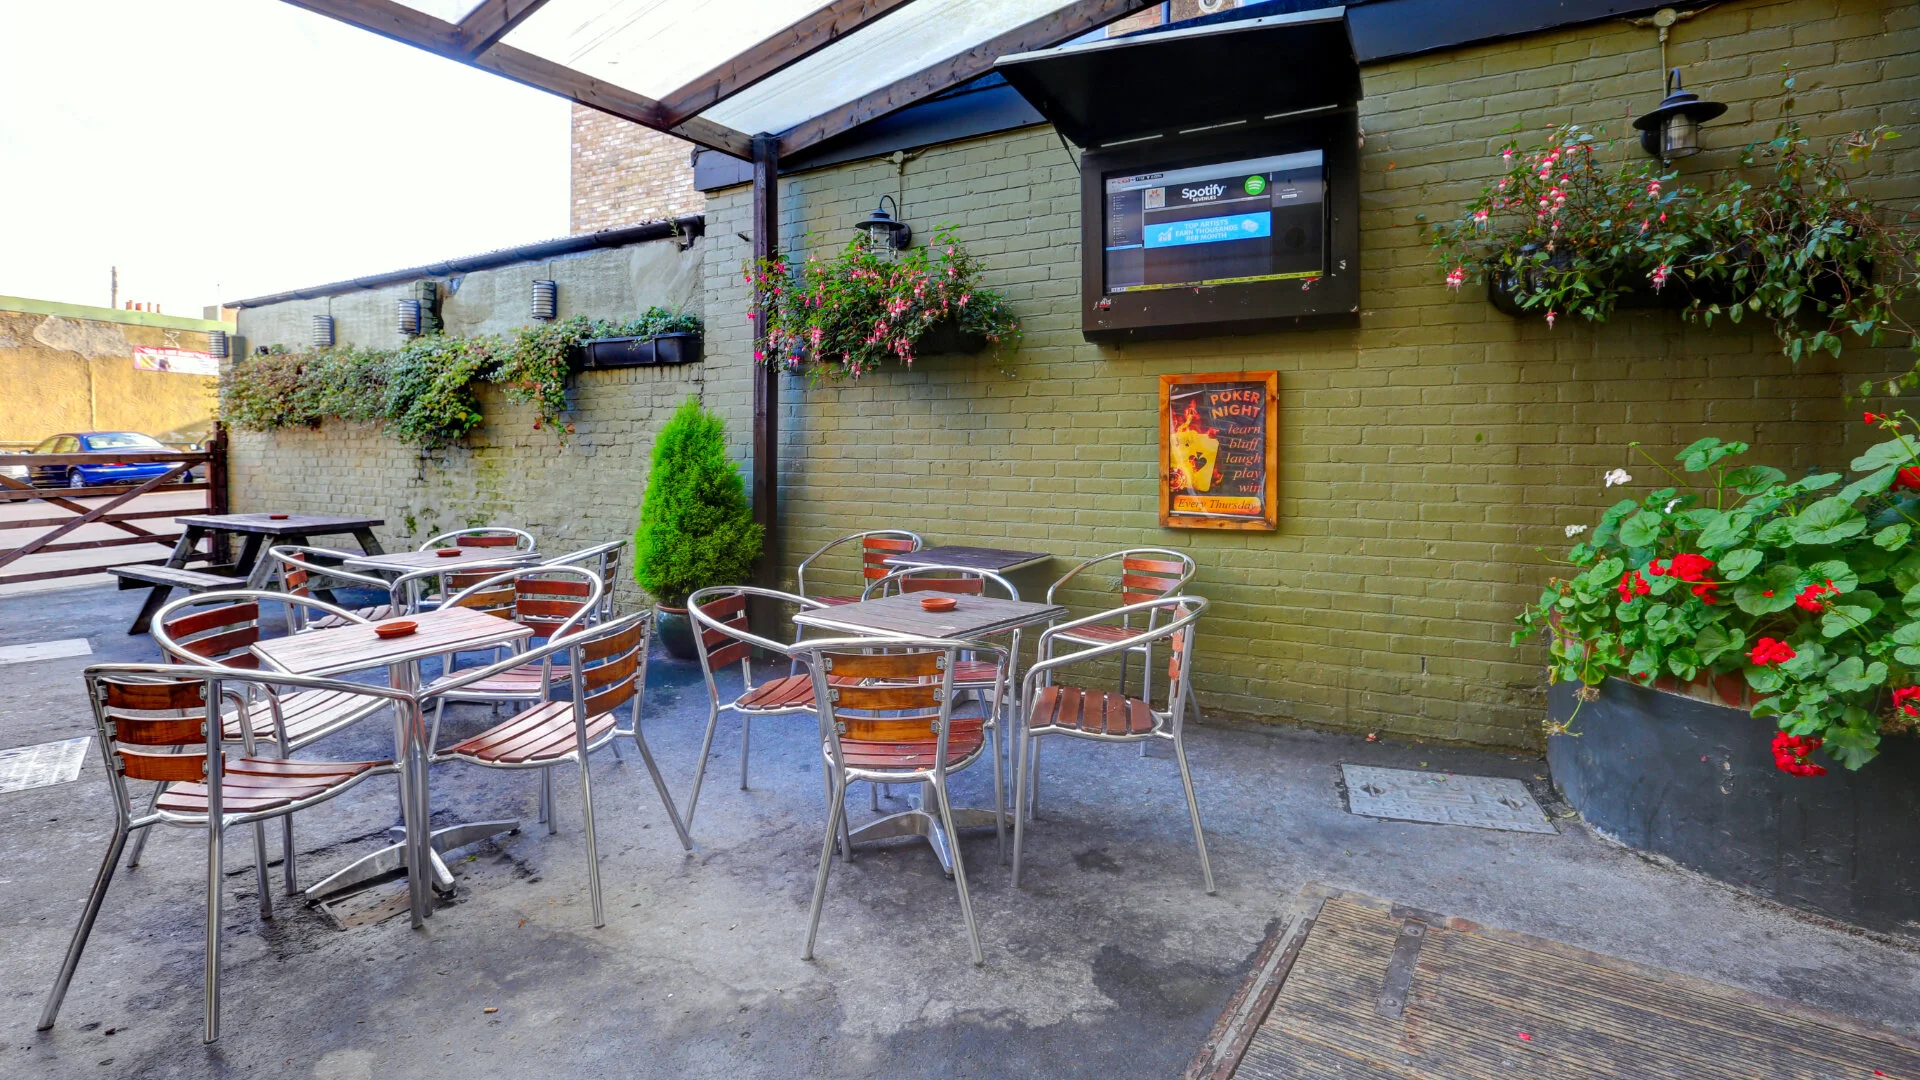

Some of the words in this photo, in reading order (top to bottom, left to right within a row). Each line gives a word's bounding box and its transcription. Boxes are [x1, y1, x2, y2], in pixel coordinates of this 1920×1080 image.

[1182, 184, 1224, 199] Spotify
[1200, 219, 1229, 228] ARTISTS
[1175, 229, 1194, 237] EARN
[1195, 225, 1239, 234] THOUSANDS
[1200, 232, 1227, 240] MONTH
[1210, 390, 1260, 405] POKER
[1211, 404, 1260, 419] NIGHT
[1228, 424, 1261, 434] learn
[1229, 437, 1261, 451] bluff
[1225, 453, 1261, 466] laugh
[1233, 467, 1261, 480] play
[1239, 482, 1261, 492] win
[1178, 499, 1206, 510] Every
[1209, 499, 1256, 511] Thursday
